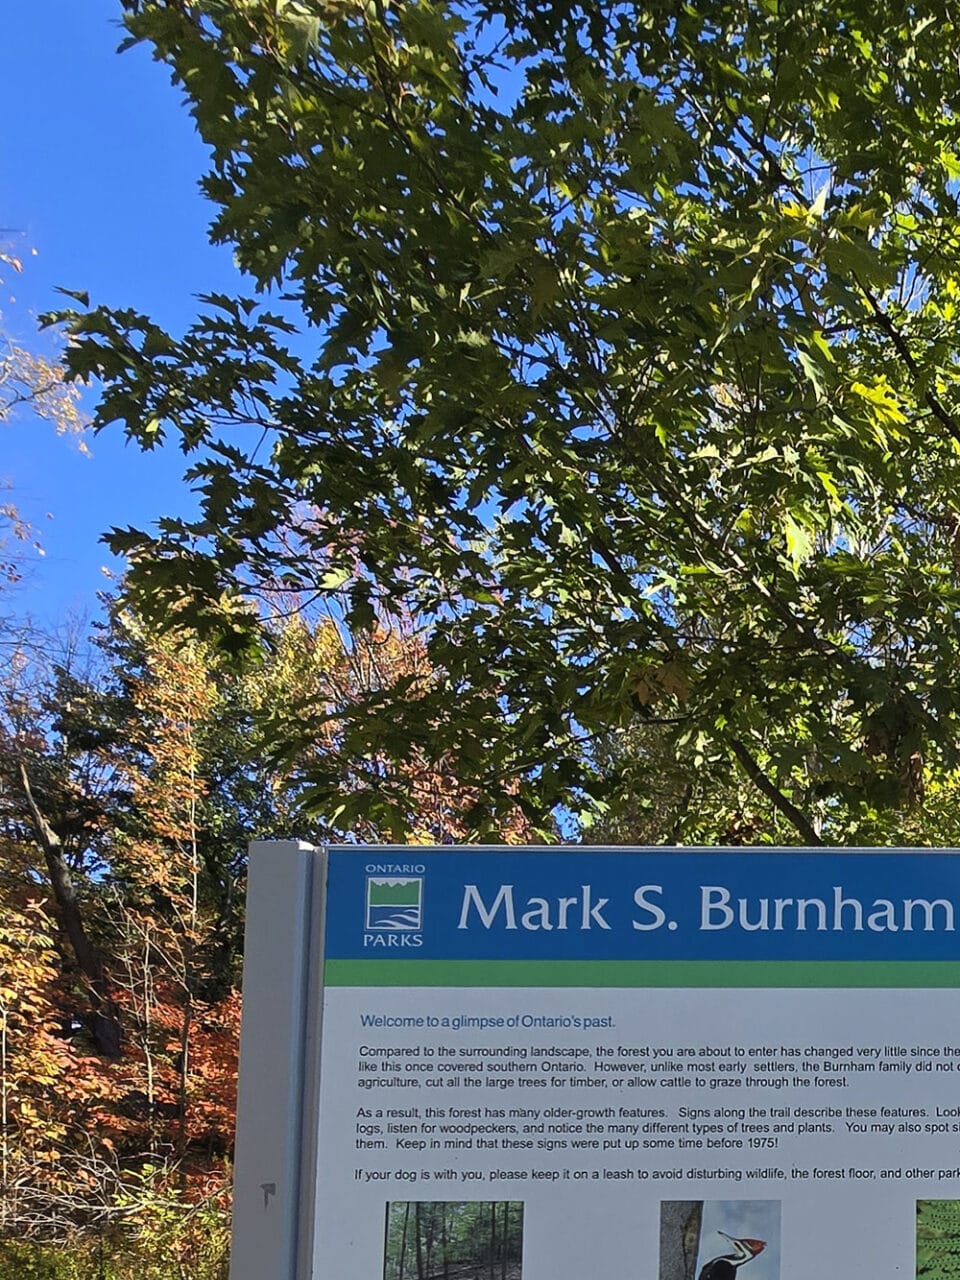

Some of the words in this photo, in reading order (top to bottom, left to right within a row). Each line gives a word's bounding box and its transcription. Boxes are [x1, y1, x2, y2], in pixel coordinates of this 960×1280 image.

[365, 864, 426, 873] ONTARIO
[459, 885, 609, 931] Mark
[633, 885, 676, 931] S.
[700, 885, 953, 931] Burnham
[364, 934, 423, 947] PARKS
[360, 1014, 424, 1028] Welcome
[426, 1015, 439, 1028] to
[441, 1017, 449, 1028] a
[452, 1014, 504, 1031] glimpse
[506, 1014, 519, 1028] of
[521, 1014, 581, 1028] Ontario's
[583, 1015, 615, 1031] past.
[359, 1046, 419, 1059] Compared
[423, 1046, 434, 1057] to
[438, 1046, 455, 1057] the
[459, 1046, 527, 1059] surrounding
[530, 1046, 591, 1059] landscape,
[596, 1046, 613, 1057] the
[617, 1046, 649, 1057] forest
[652, 1048, 673, 1059] you
[676, 1048, 695, 1057] are
[698, 1046, 730, 1057] about
[734, 1046, 744, 1057] to
[748, 1046, 777, 1057] enter
[780, 1046, 800, 1057] has
[804, 1046, 853, 1059] changed
[856, 1048, 881, 1059] very
[884, 1046, 906, 1057] little
[910, 1046, 939, 1057] since
[943, 1046, 960, 1057] the
[358, 1077, 420, 1090] agriculture,
[425, 1077, 443, 1088] cut
[446, 1077, 459, 1088] all
[464, 1077, 481, 1088] the
[485, 1077, 514, 1090] large
[518, 1077, 546, 1088] trees
[551, 1076, 566, 1087] for
[570, 1076, 607, 1089] timber,
[612, 1079, 623, 1087] or
[627, 1076, 656, 1087] allow
[660, 1076, 691, 1087] cattle
[695, 1077, 705, 1087] to
[709, 1078, 741, 1090] graze
[745, 1076, 788, 1090] through
[793, 1076, 810, 1087] the
[814, 1076, 848, 1087] forest.
[356, 1138, 387, 1149] them.
[396, 1138, 426, 1151] Keep
[430, 1138, 440, 1149] in
[444, 1138, 472, 1149] mind
[476, 1137, 497, 1149] that
[501, 1137, 533, 1149] these
[537, 1138, 567, 1151] signs
[571, 1140, 599, 1148] were
[603, 1138, 620, 1151] put
[624, 1140, 639, 1151] up
[642, 1139, 674, 1148] some
[678, 1138, 702, 1148] time
[706, 1137, 742, 1148] before
[748, 1137, 777, 1148] 1975!
